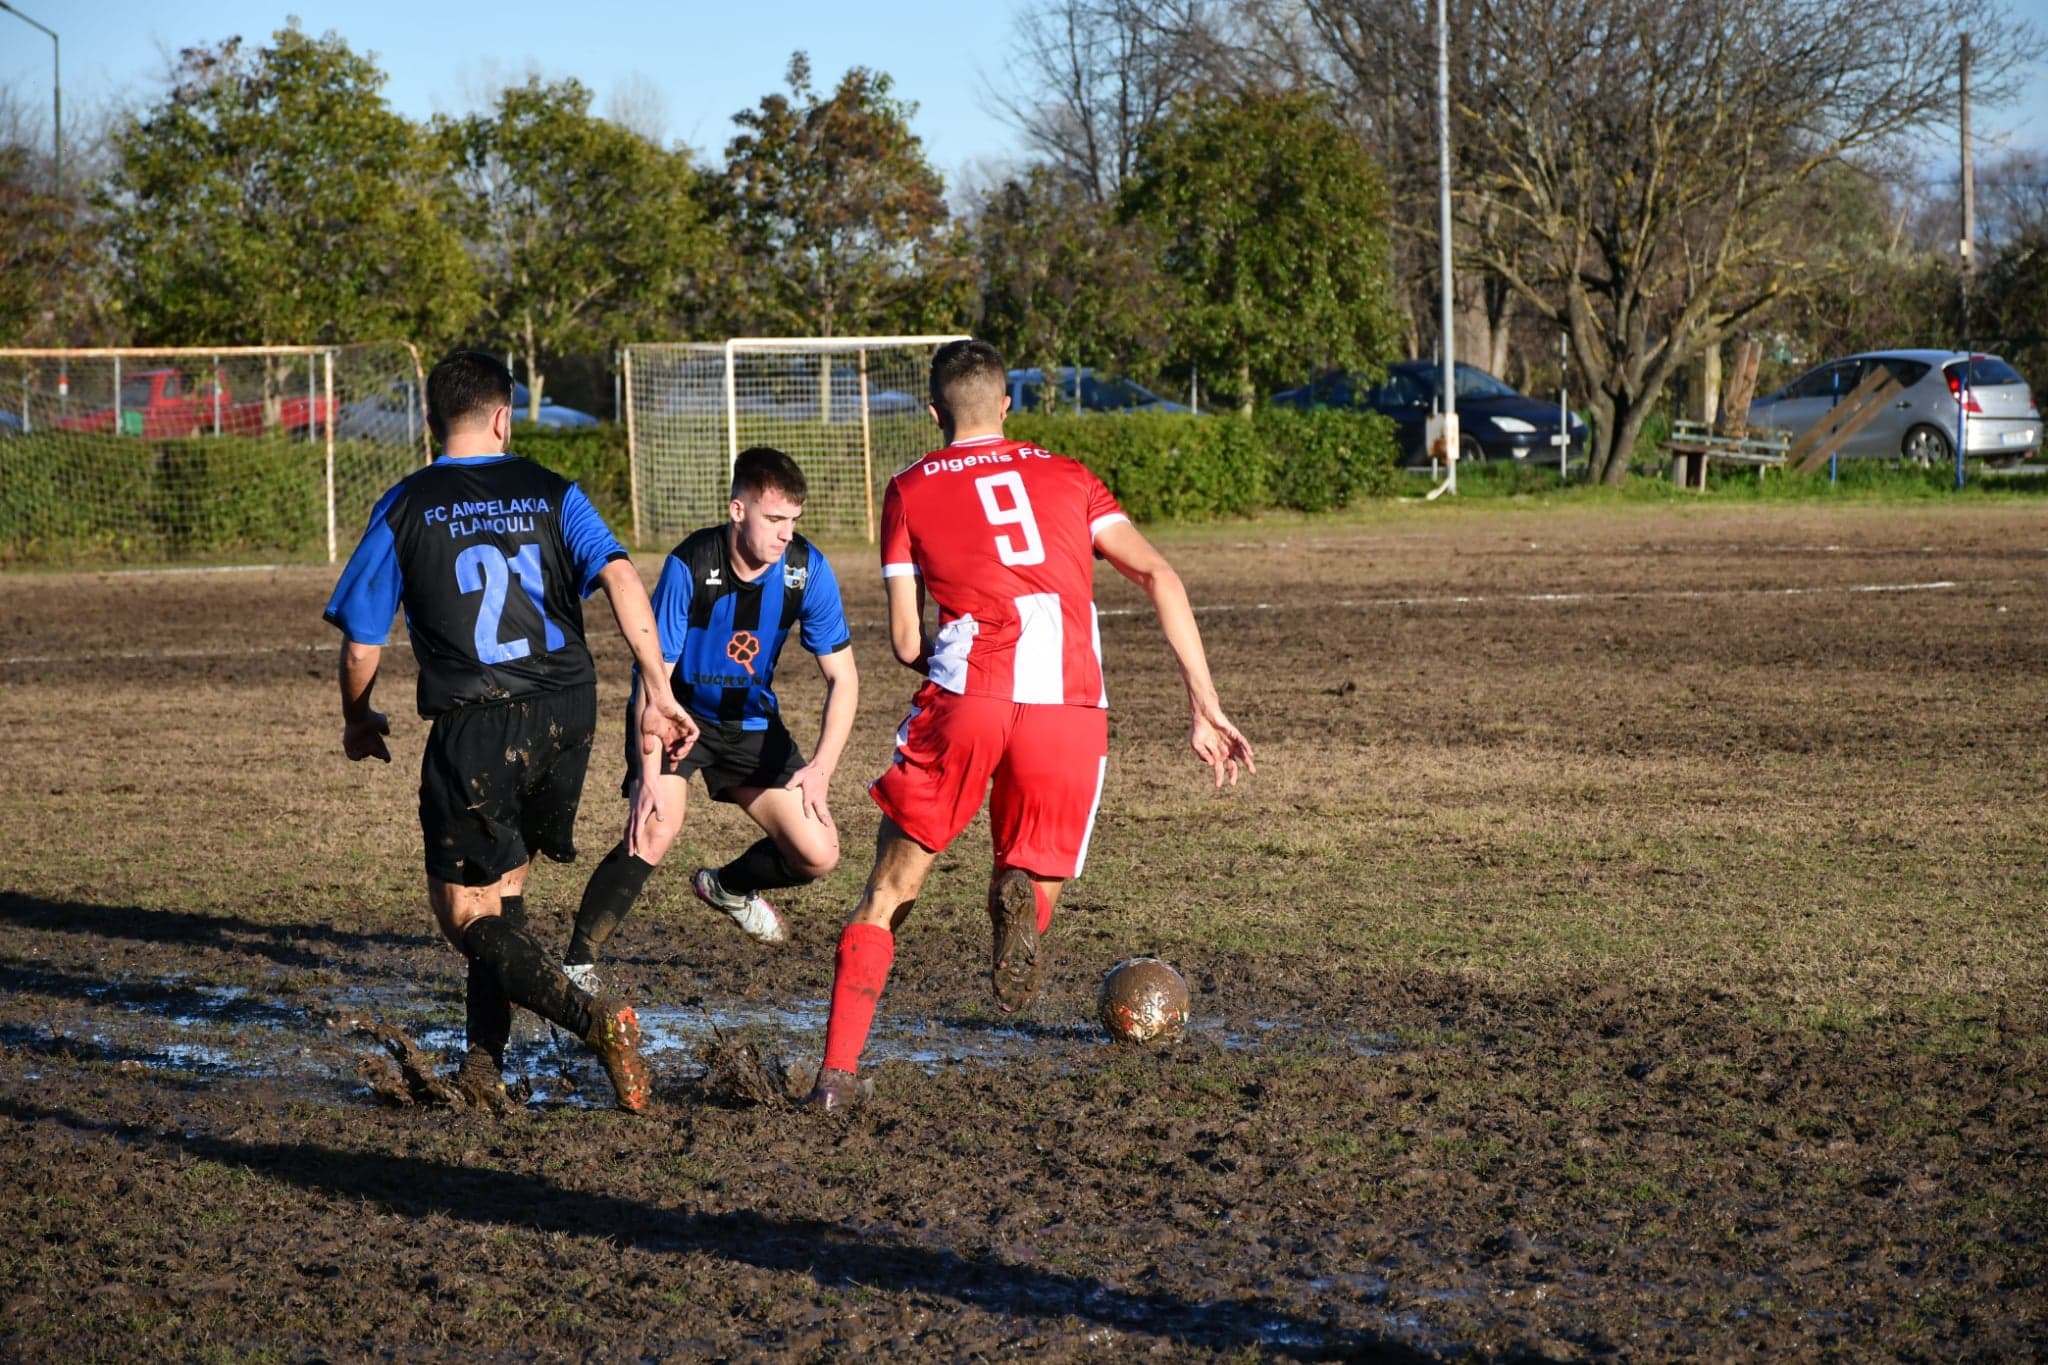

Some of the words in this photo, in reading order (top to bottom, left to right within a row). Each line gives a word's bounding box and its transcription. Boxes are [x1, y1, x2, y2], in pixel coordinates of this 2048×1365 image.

[923, 450, 1013, 476] Digenis
[1019, 447, 1053, 461] FC
[424, 506, 448, 526] FC
[452, 497, 550, 518] AMPELAKIA
[974, 469, 1046, 567] 9
[455, 543, 567, 665] 21
